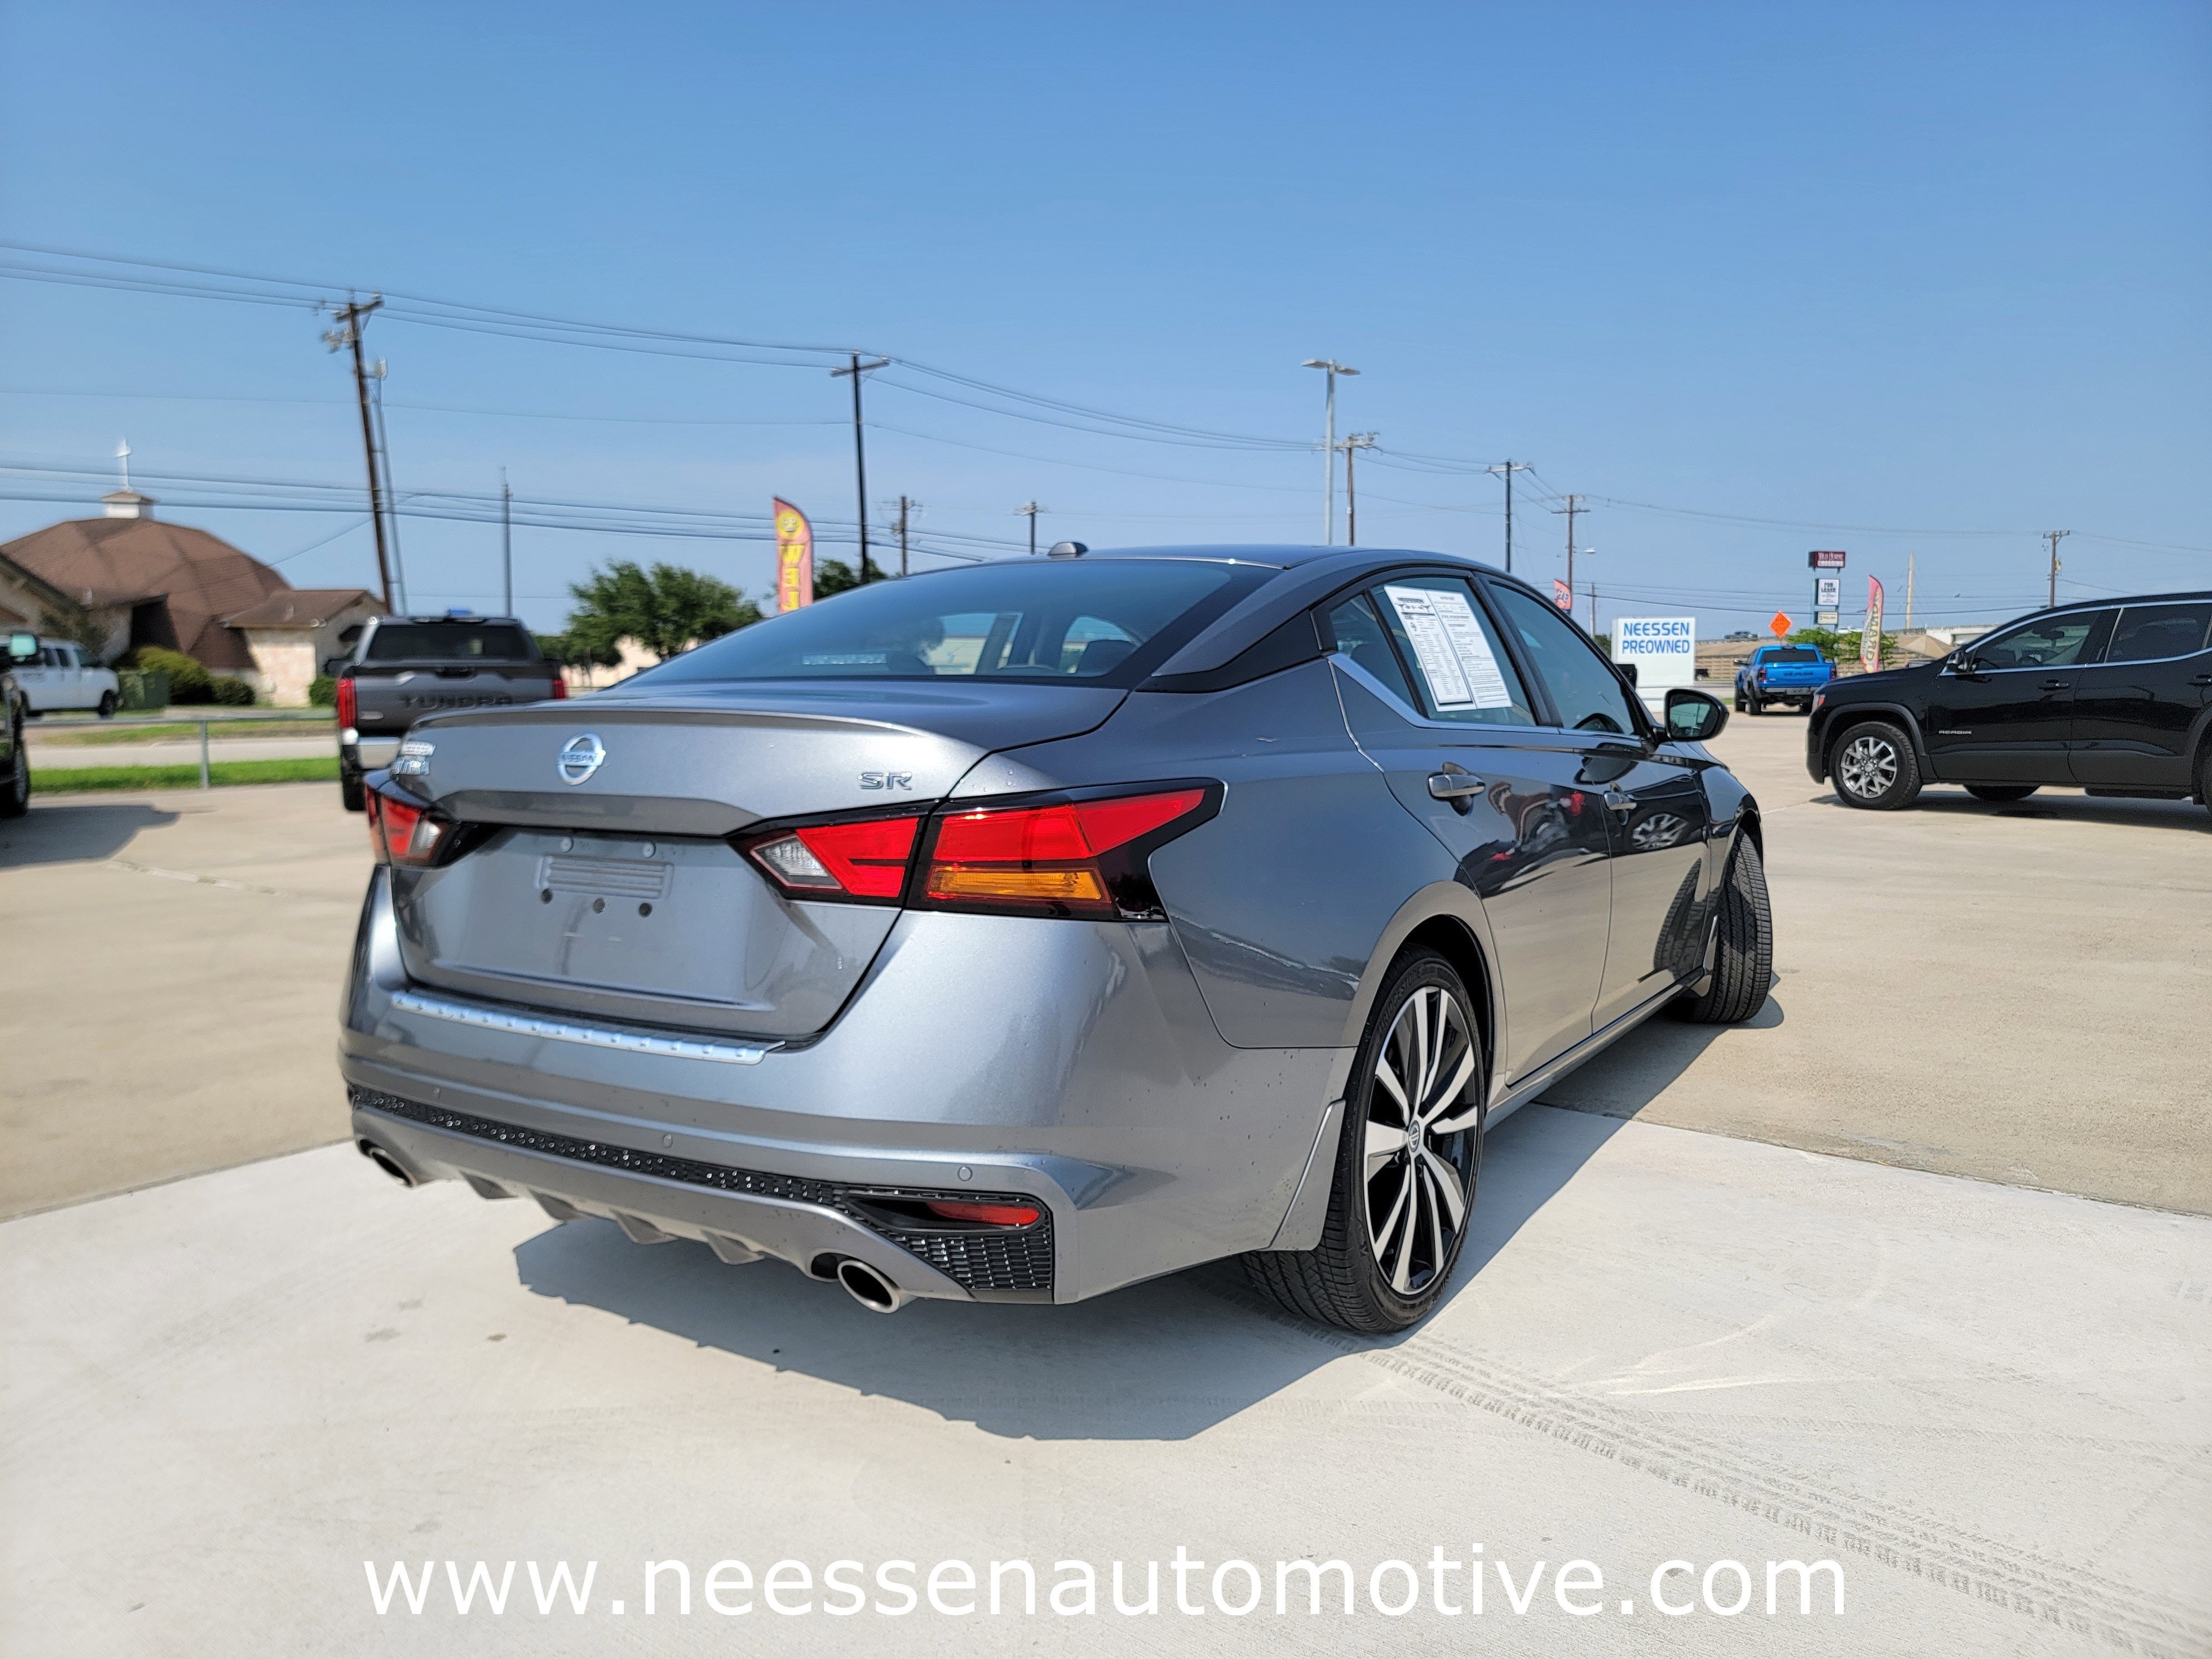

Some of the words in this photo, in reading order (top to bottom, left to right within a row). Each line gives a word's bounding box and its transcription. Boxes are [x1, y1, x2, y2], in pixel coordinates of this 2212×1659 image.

[1624, 622, 1689, 636] NEESSEN
[1622, 640, 1690, 654] PREOWNED
[400, 695, 514, 711] TUNDRA
[561, 754, 594, 763] NISSAN
[858, 771, 912, 790] SR
